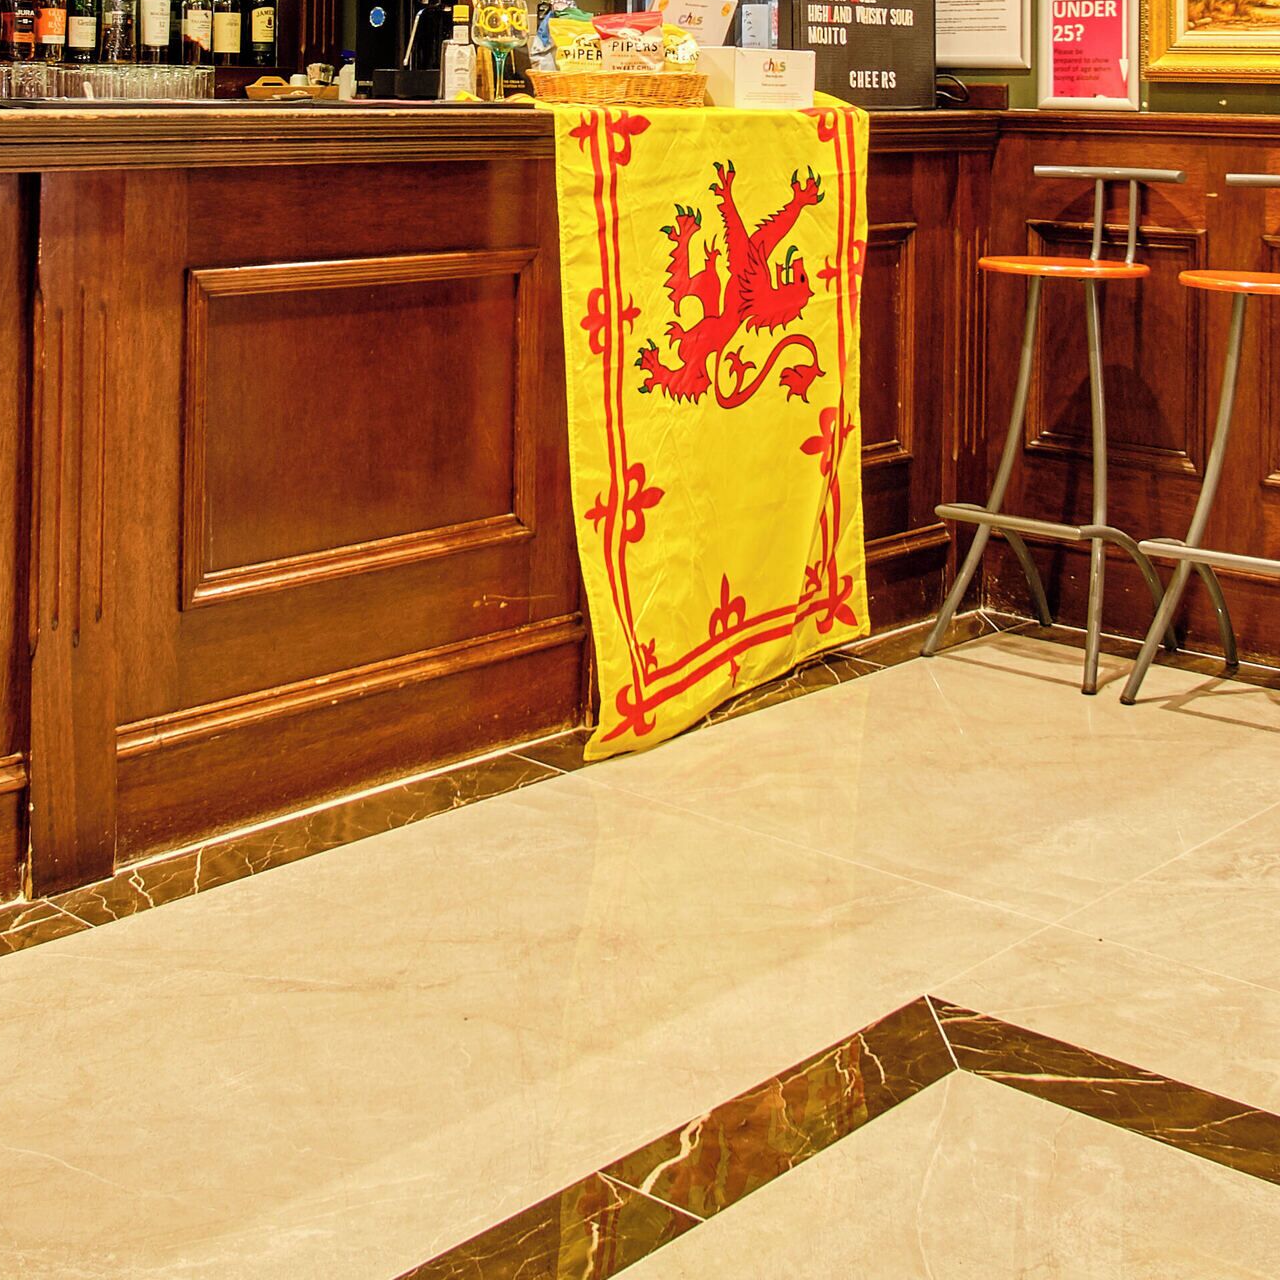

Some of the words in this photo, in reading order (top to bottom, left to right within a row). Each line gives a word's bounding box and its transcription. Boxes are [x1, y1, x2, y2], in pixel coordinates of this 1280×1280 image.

[807, 4, 852, 24] HIGHLAND
[855, 5, 888, 25] WHISKY
[889, 8, 914, 26] SOUR
[1053, 0, 1118, 18] UNDER
[807, 26, 848, 45] MOJITO
[1053, 23, 1085, 42] 25?
[563, 48, 603, 61] PIPER
[849, 70, 897, 89] CHEERS
